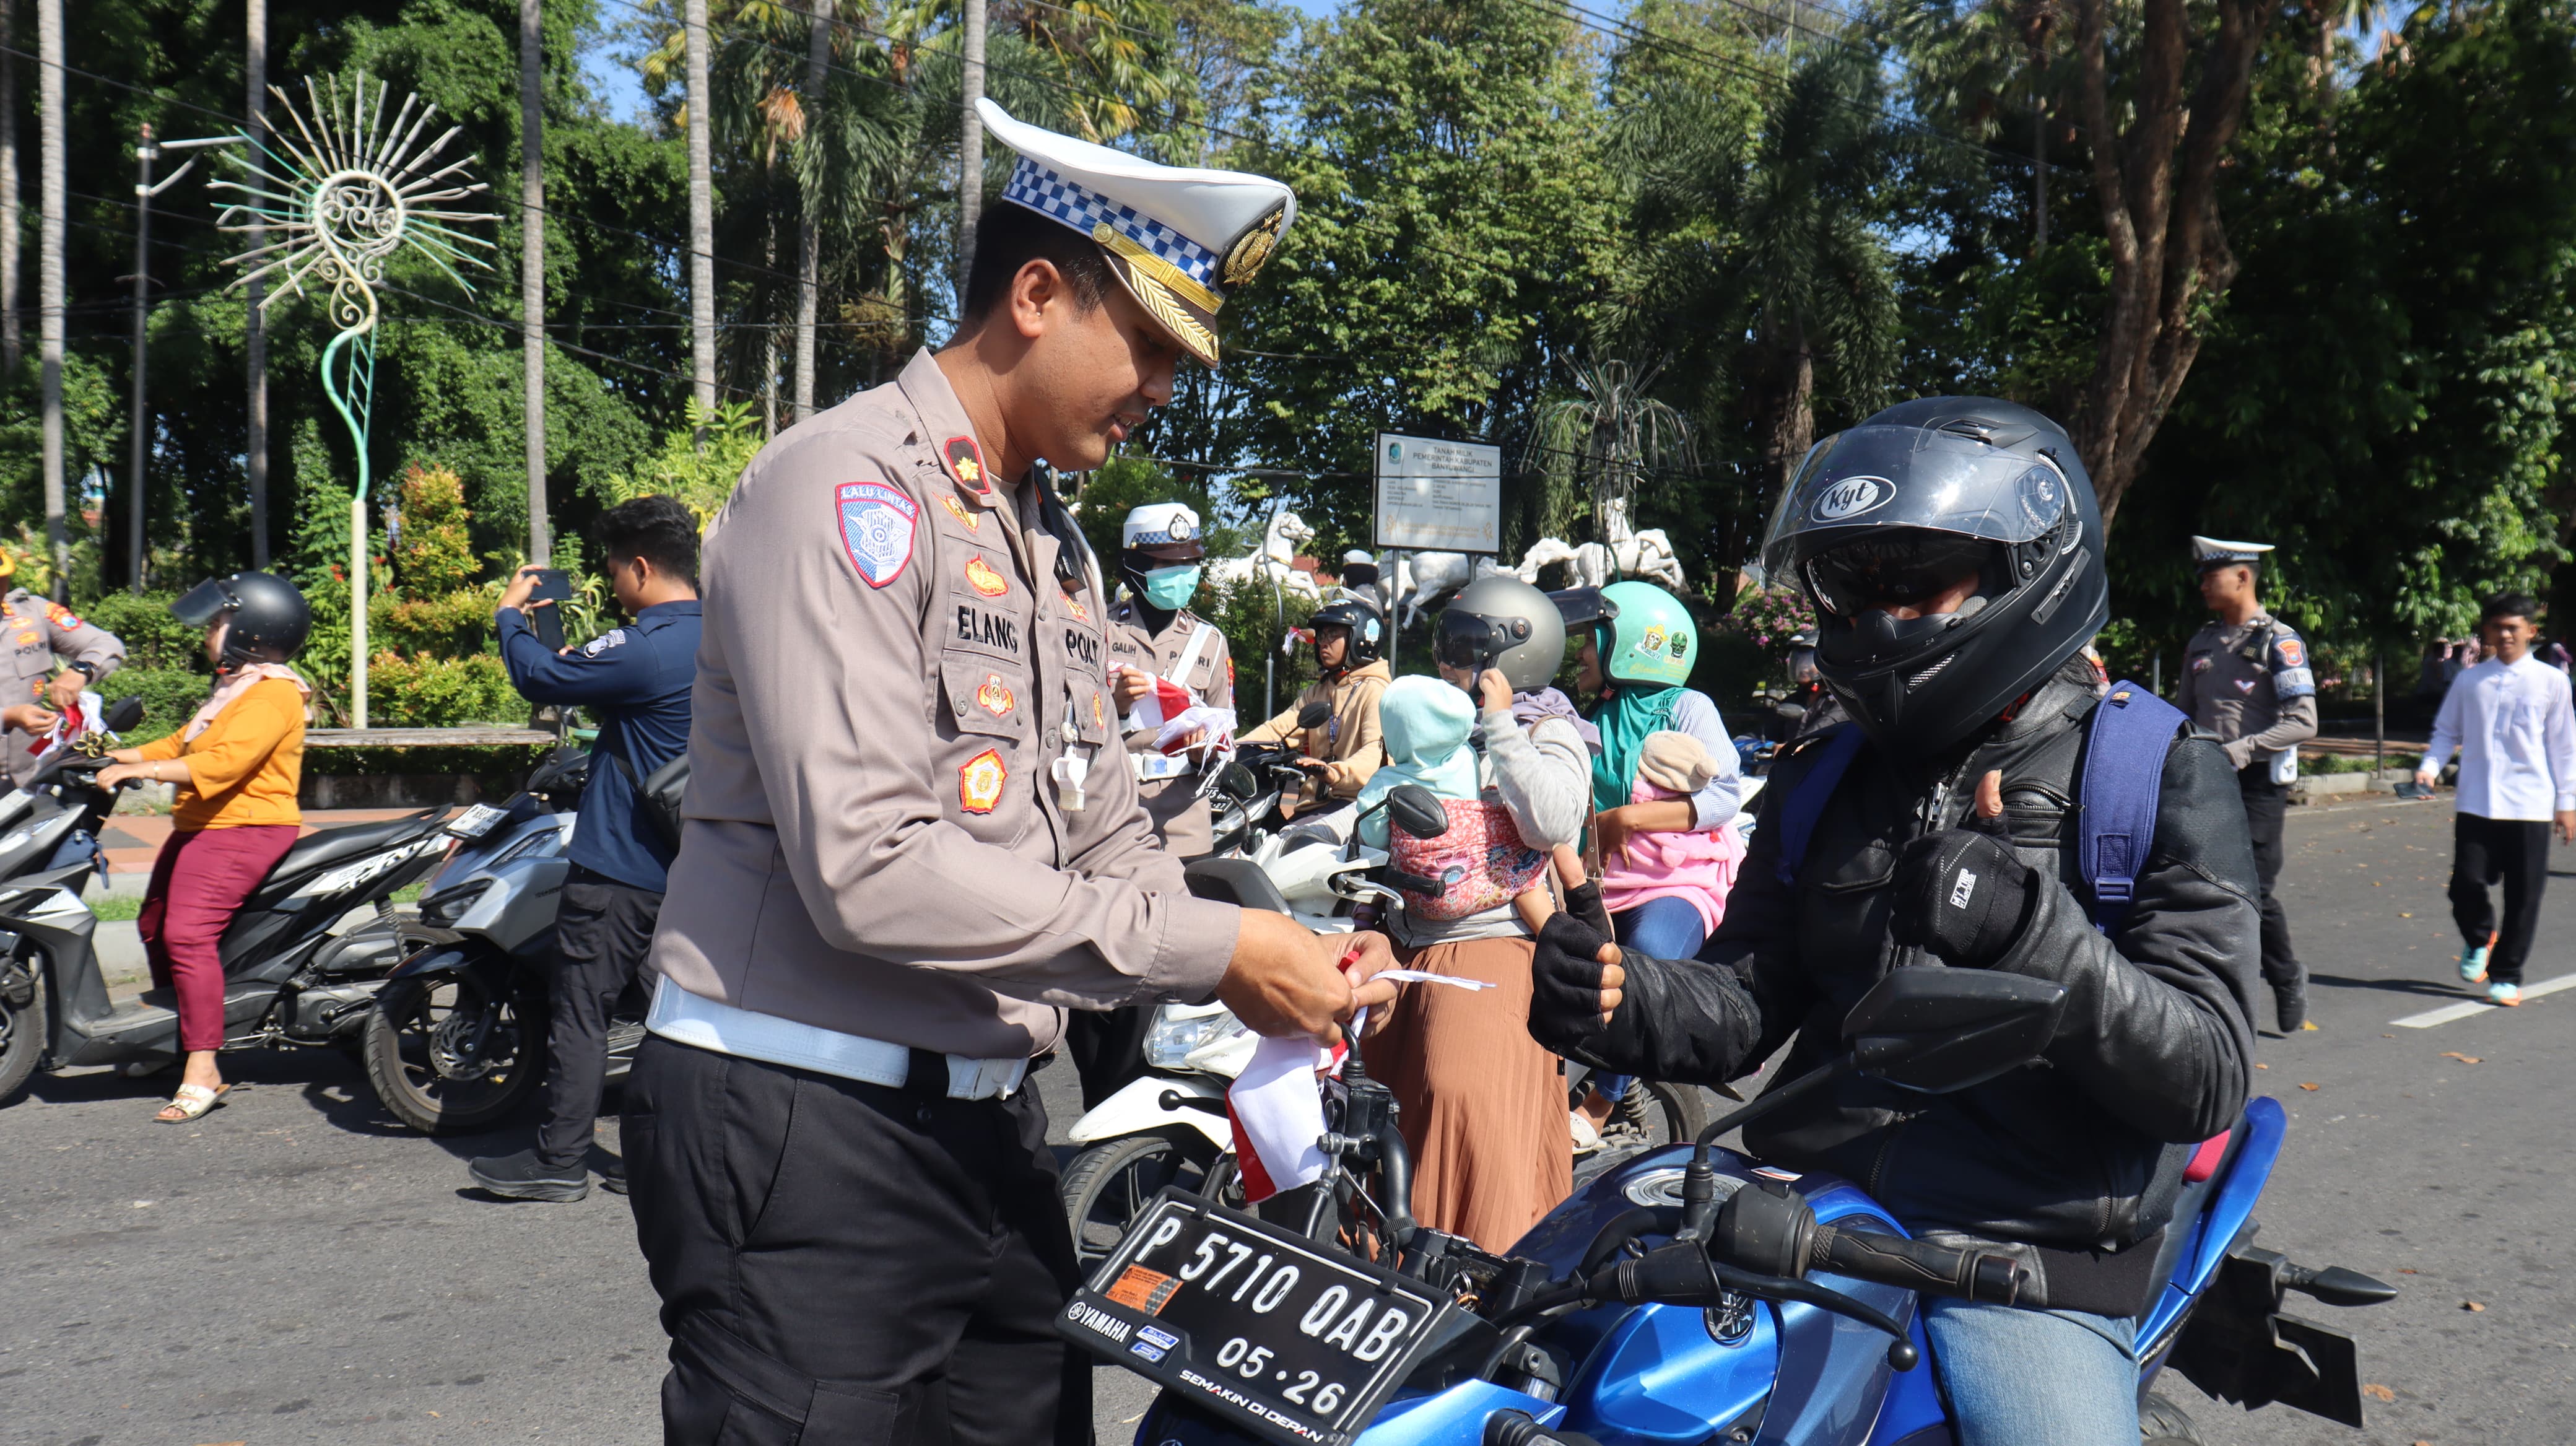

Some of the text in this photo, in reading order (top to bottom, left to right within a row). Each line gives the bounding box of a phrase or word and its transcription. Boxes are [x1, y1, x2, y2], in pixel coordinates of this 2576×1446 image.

[1413, 452, 1492, 467] PEMERINTAH KABUPATEN
[1434, 446, 1473, 457] TANAH MILIK
[1432, 463, 1474, 472] BANYUWANGI
[842, 487, 913, 515] LALU LINTAS
[957, 605, 1017, 654] ELANG
[1112, 642, 1136, 655] GALIH
[1170, 651, 1209, 668] PRI
[1135, 1217, 1181, 1263] P
[1180, 1232, 1299, 1313] 5710
[1079, 1307, 1131, 1343] YAMAHA
[1142, 1334, 1167, 1347] CORE
[1147, 1328, 1173, 1343] BLUE
[1264, 1410, 1323, 1443] DEPAN
